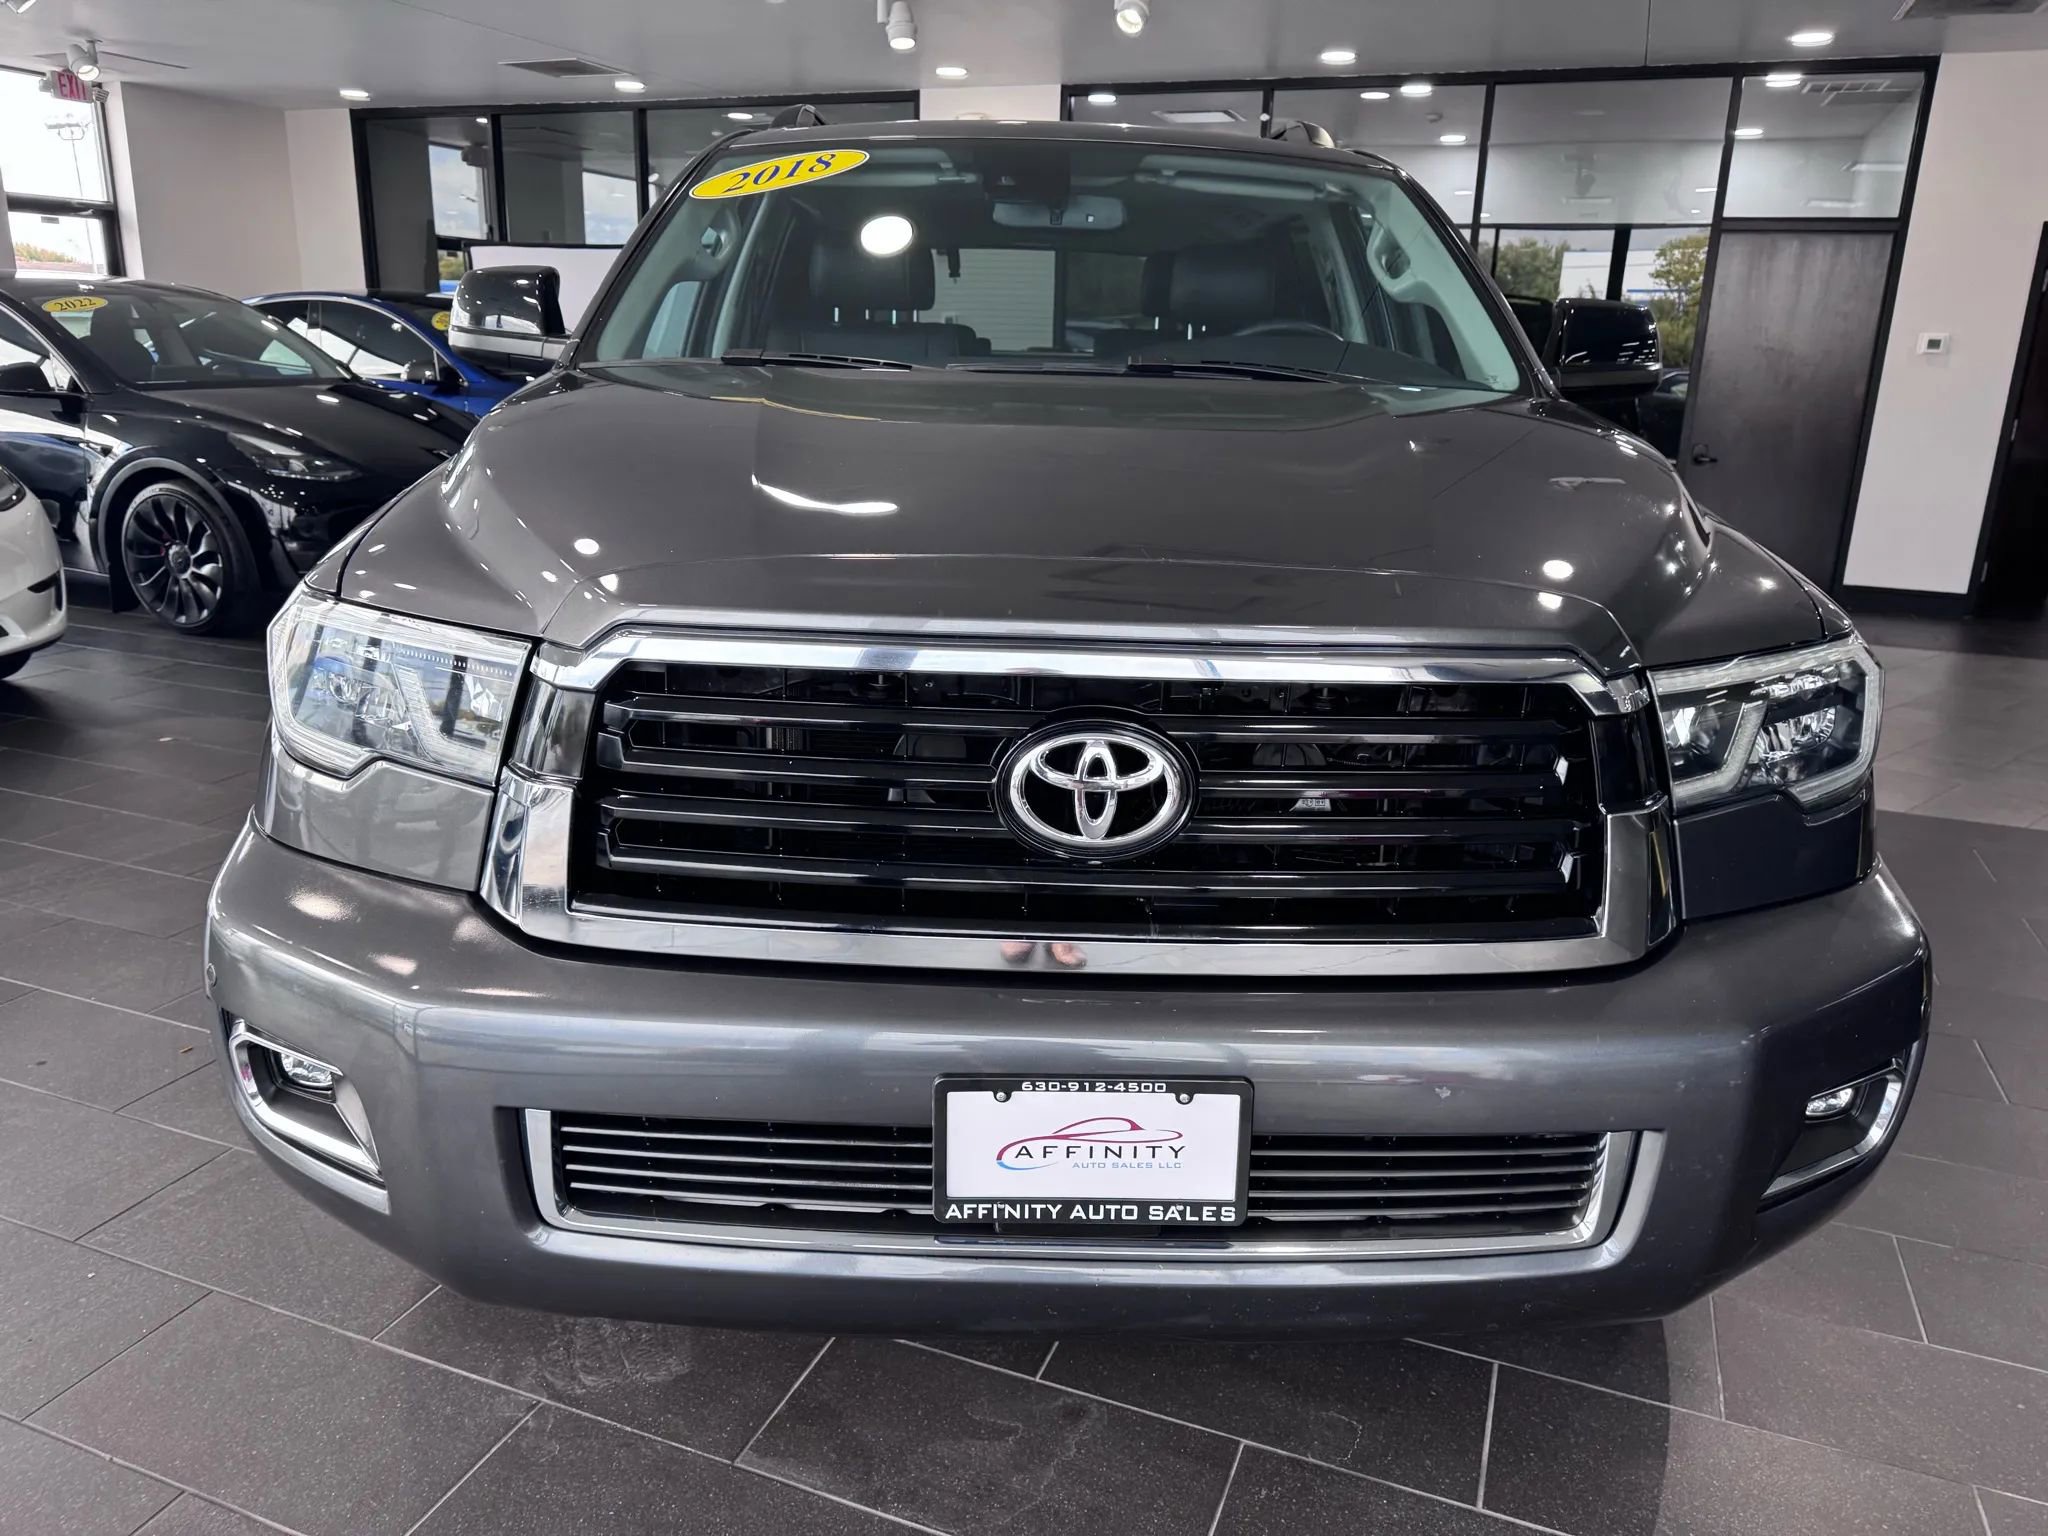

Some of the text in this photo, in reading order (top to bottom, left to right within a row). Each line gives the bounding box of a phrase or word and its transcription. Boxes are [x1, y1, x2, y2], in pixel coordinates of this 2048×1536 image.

[721, 153, 837, 194] 2018
[54, 297, 97, 312] 2022
[1021, 1081, 1168, 1093] 630-912-4500
[1014, 1145, 1187, 1160] AFFINITY
[1071, 1161, 1107, 1169] AUTO
[945, 1204, 1237, 1223] AFFINITY AUTO SALES
